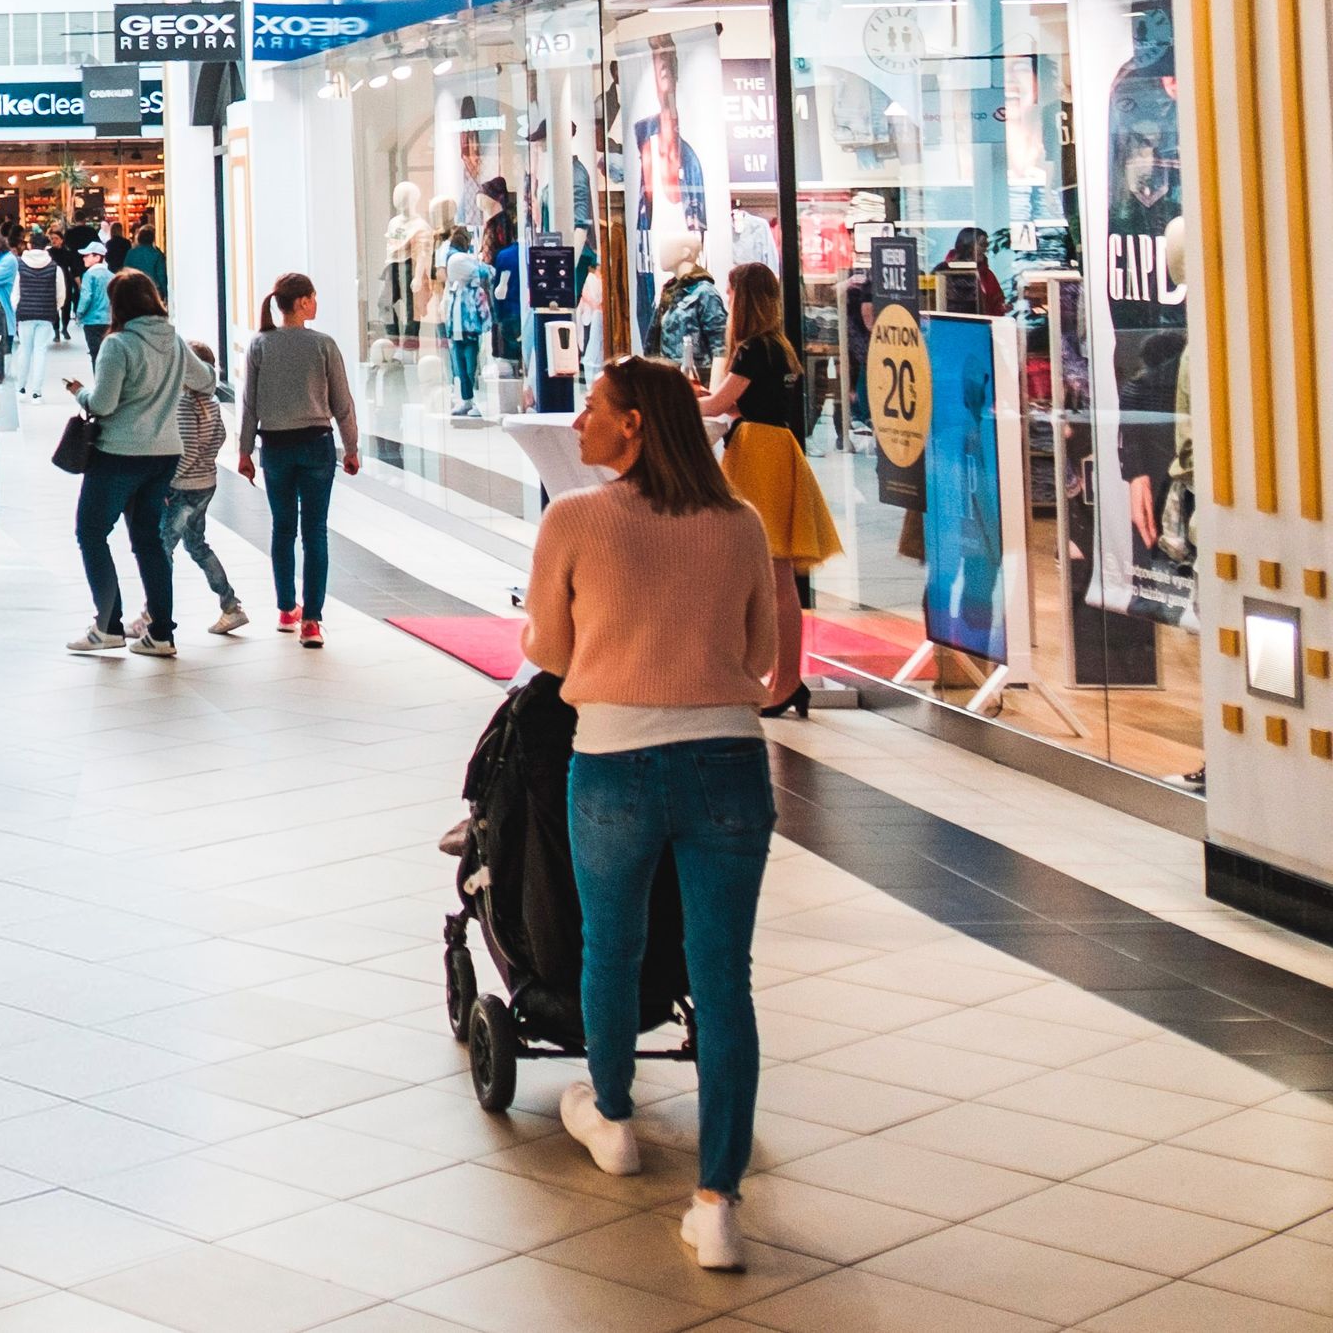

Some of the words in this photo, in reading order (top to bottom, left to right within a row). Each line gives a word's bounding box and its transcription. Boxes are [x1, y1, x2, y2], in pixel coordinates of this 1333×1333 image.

[119, 14, 236, 37] GEOX
[120, 35, 236, 51] RESPIRA
[733, 77, 766, 91] THE
[743, 154, 767, 172] GAP
[882, 266, 907, 291] SALE
[876, 326, 920, 348] AKTION
